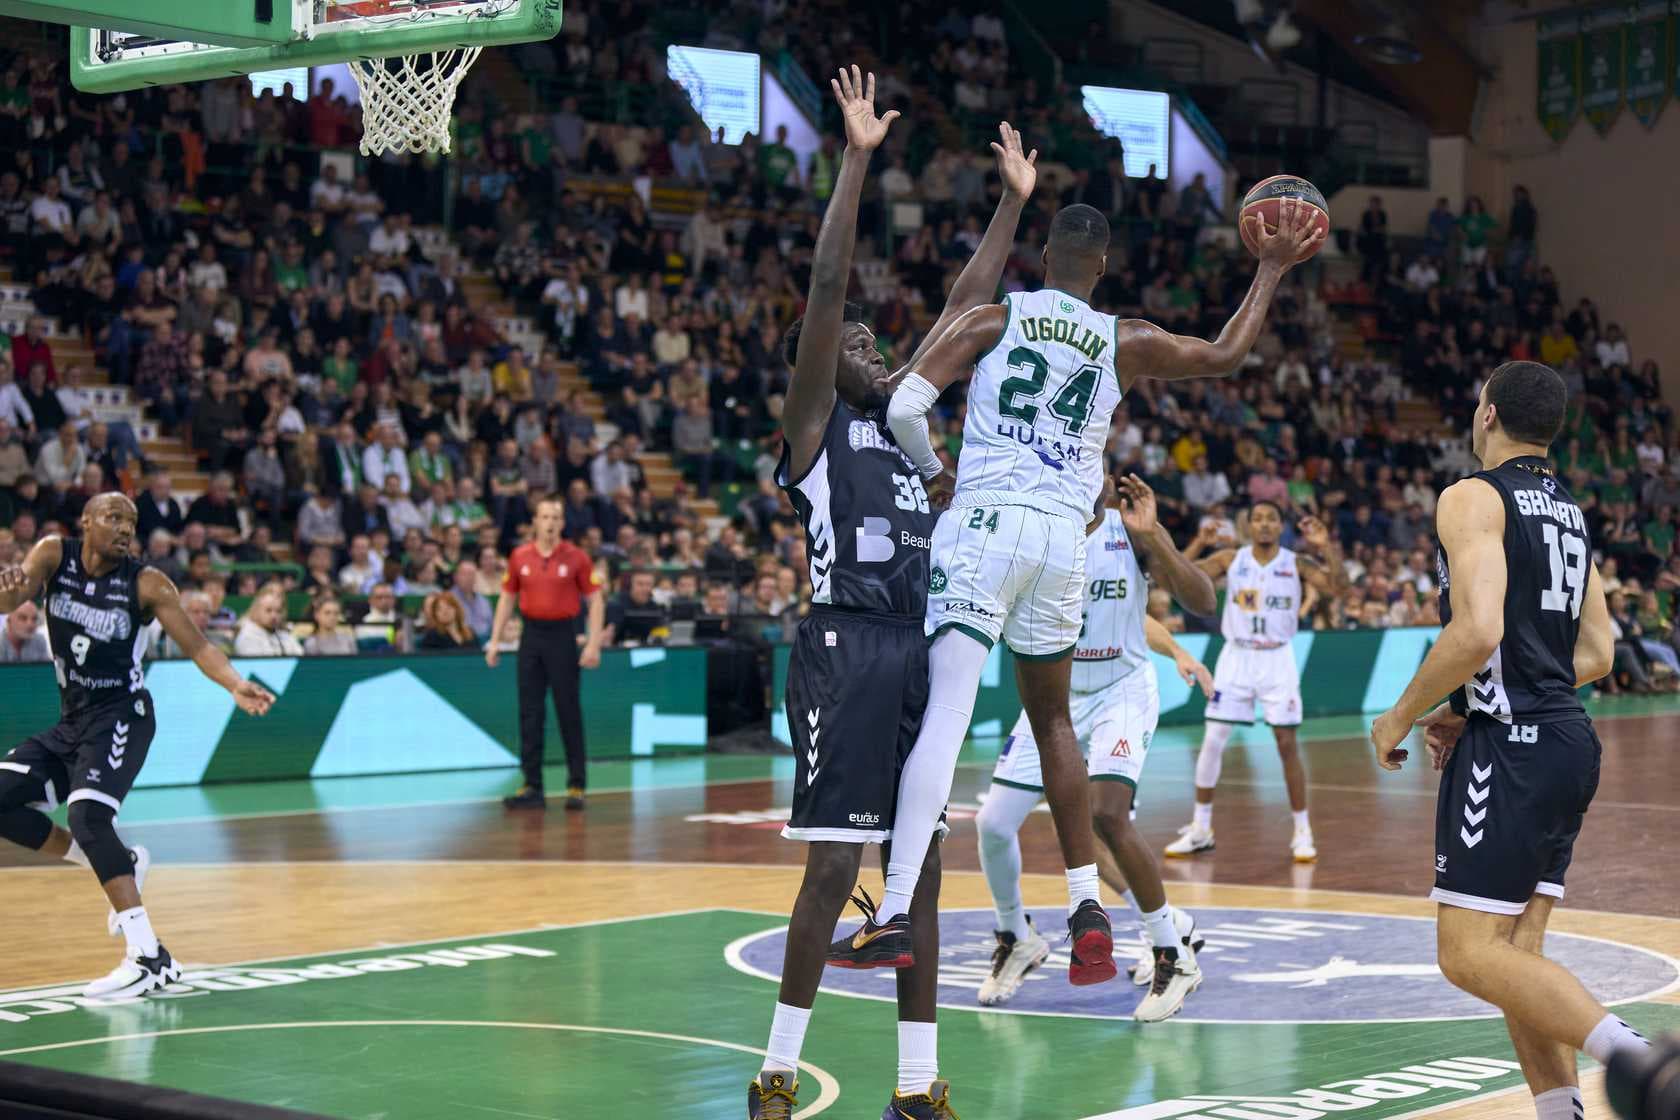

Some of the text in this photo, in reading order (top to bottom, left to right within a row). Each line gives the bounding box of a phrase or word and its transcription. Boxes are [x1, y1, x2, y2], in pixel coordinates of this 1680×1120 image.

[1020, 317, 1108, 362] UGOLIN
[998, 345, 1103, 439] 24
[892, 472, 930, 514] 32
[967, 507, 1000, 534] 24
[1540, 522, 1587, 621] 19
[1252, 615, 1266, 634] 11
[70, 634, 91, 666] 9
